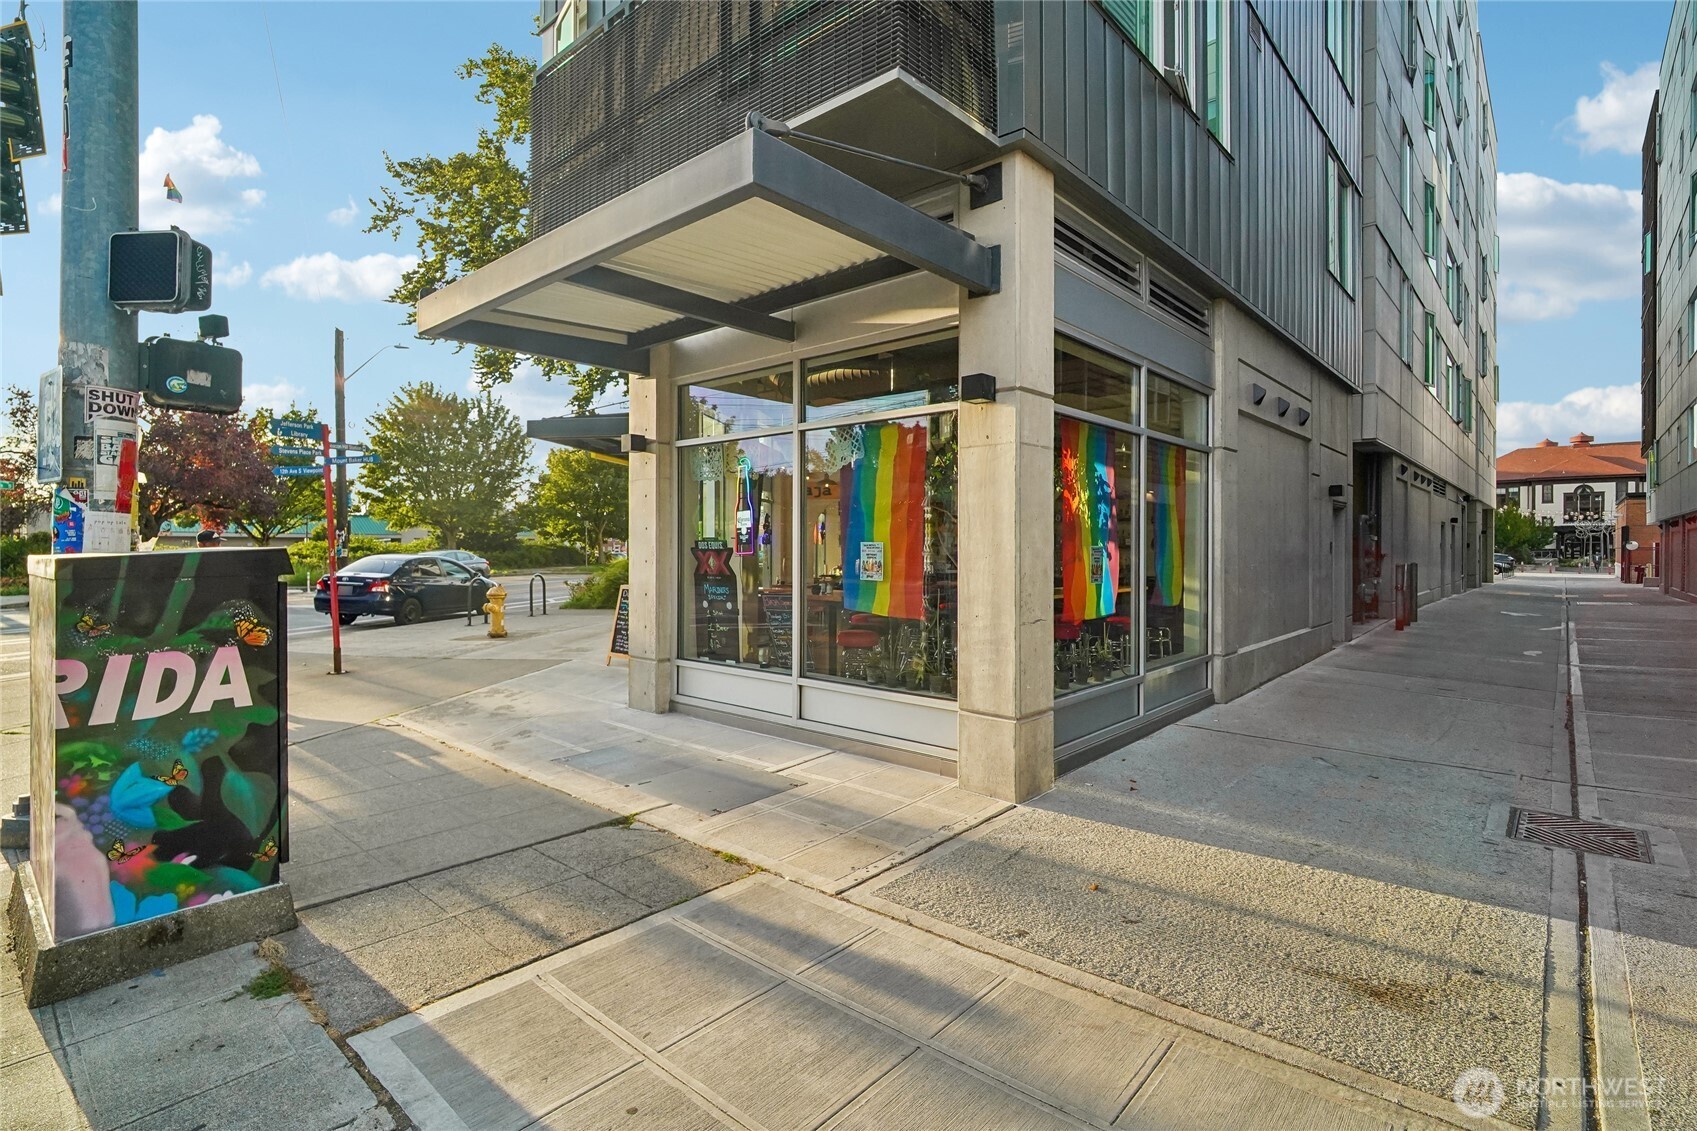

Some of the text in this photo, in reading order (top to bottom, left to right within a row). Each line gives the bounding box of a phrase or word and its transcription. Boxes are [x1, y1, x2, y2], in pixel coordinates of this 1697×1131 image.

[88, 389, 134, 405] SHUT
[280, 420, 302, 428] Jefferson
[291, 430, 308, 438] Library
[278, 447, 298, 455] Stevens
[697, 541, 708, 550] DOS
[696, 550, 731, 576] XX
[55, 646, 254, 730] RIDA
